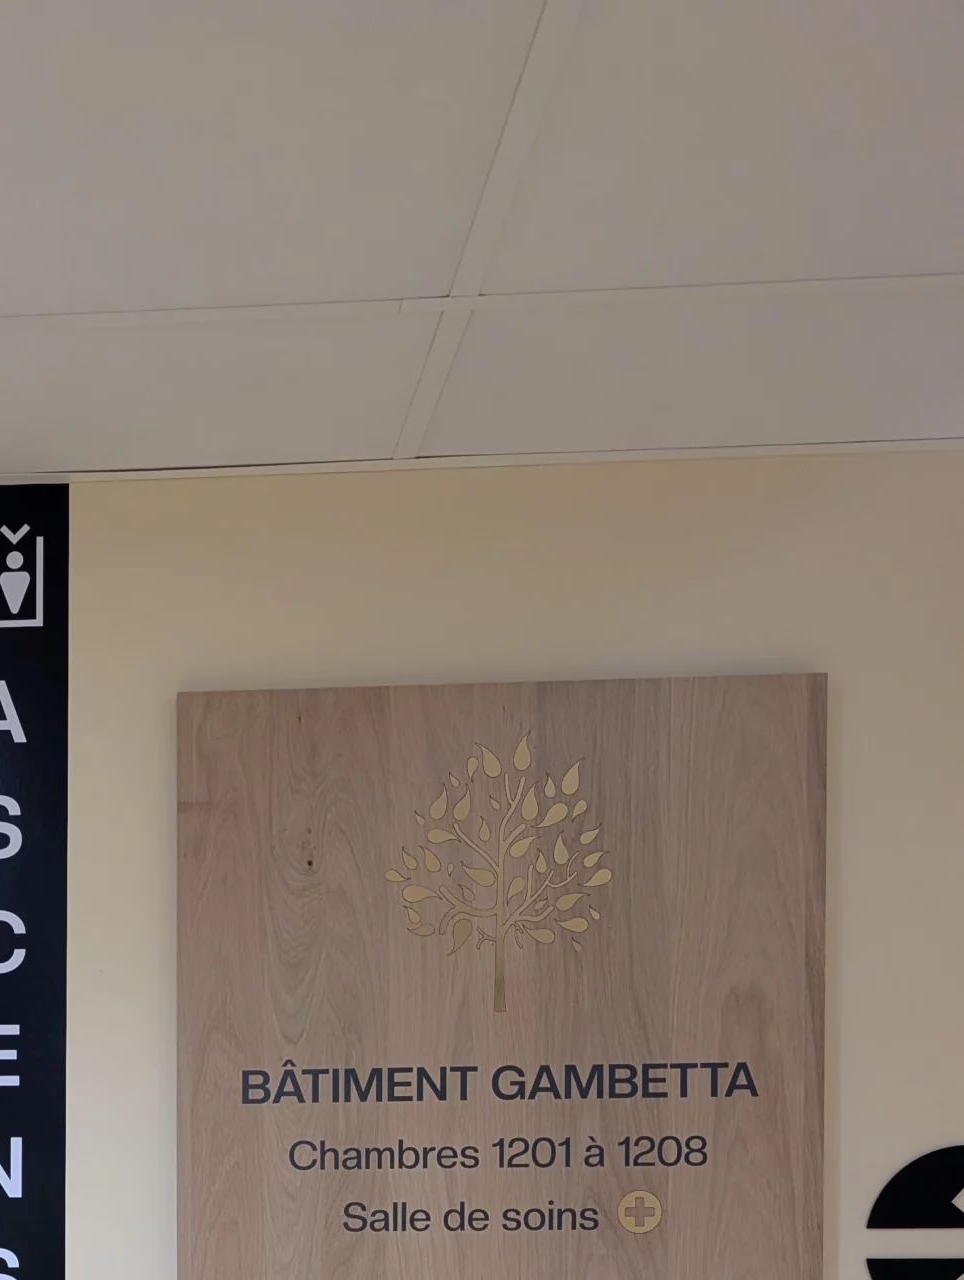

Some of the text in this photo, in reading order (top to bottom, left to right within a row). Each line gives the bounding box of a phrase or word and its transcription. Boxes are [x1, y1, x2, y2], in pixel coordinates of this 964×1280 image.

[241, 1059, 760, 1105] BÂTIMENT GAMBETTA
[288, 1135, 708, 1171] Chambres 1201 à 1208
[342, 1199, 600, 1233] Salle de soins
